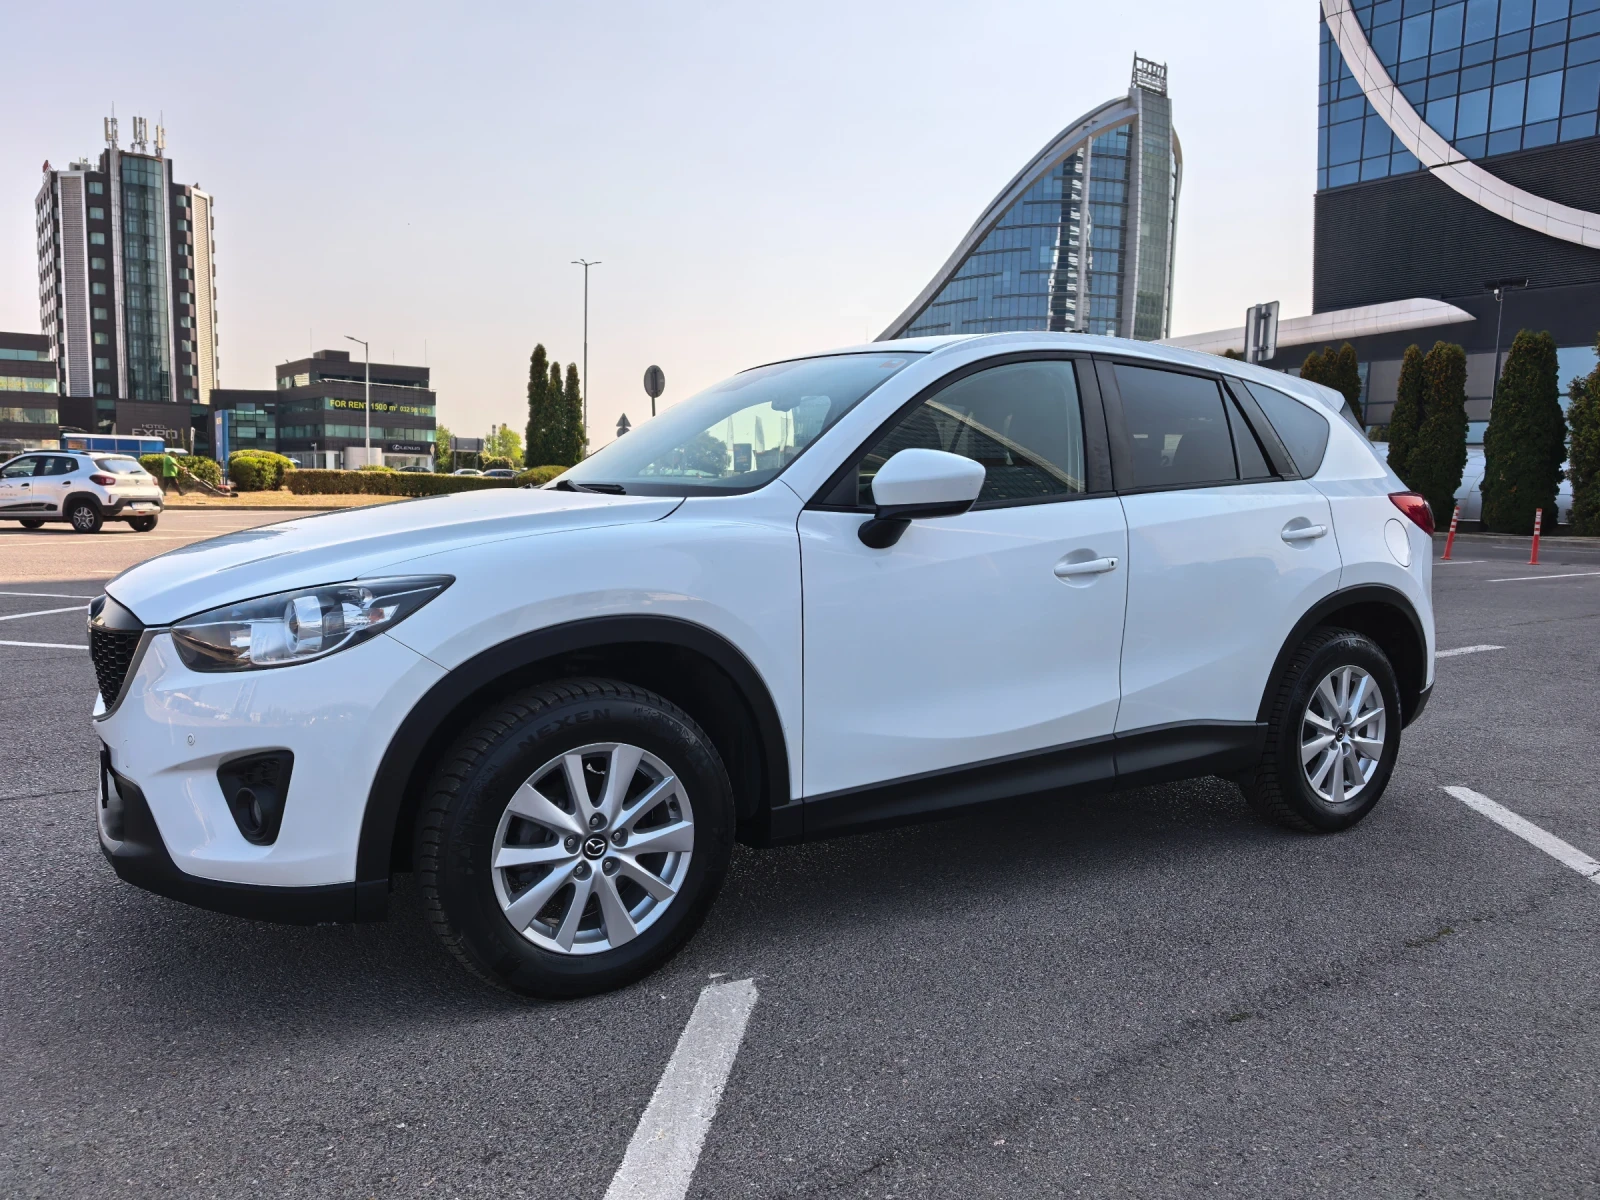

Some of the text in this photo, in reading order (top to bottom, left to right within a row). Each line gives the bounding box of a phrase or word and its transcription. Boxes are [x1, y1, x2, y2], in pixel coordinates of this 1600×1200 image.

[329, 399, 346, 408] FOR
[371, 402, 388, 411] 1500
[131, 428, 178, 440] EXPO
[516, 707, 612, 750] NEXEN
